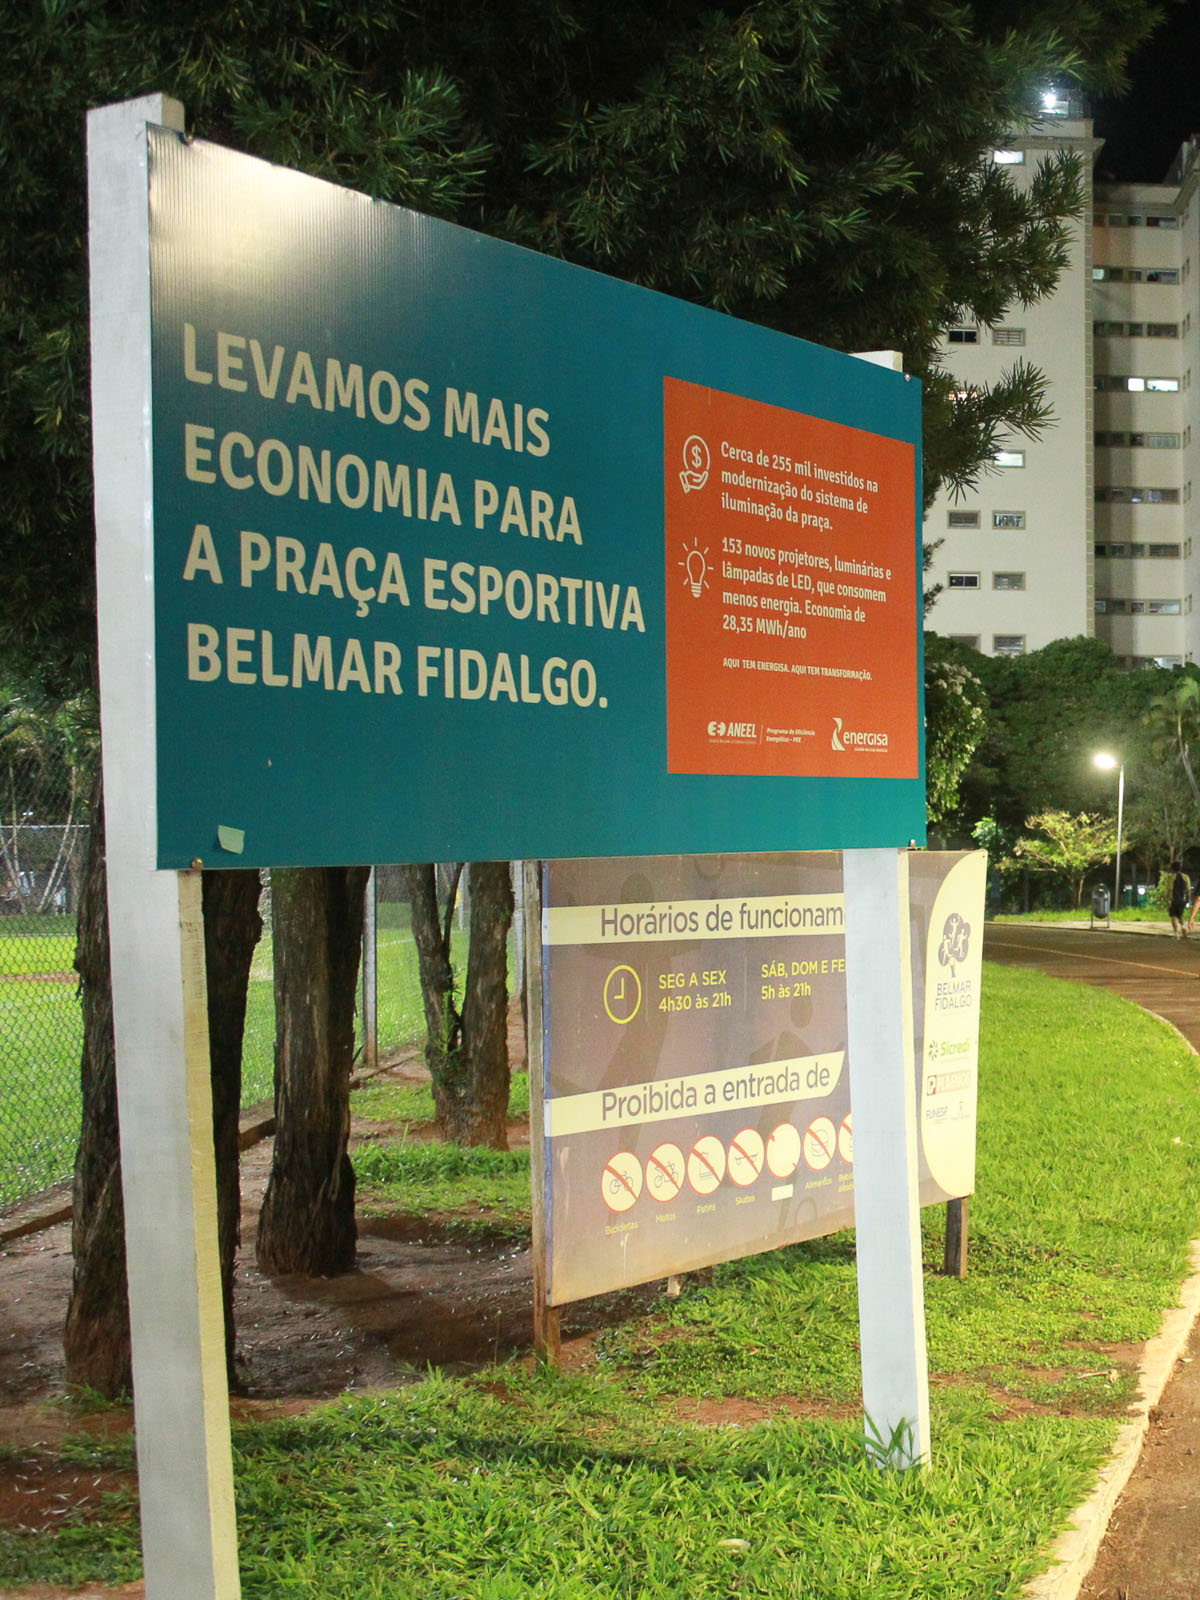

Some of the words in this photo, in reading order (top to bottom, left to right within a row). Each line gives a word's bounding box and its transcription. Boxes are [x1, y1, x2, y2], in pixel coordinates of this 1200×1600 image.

[184, 322, 431, 431] LEVAMOS
[444, 387, 551, 457] MAIS
[721, 441, 753, 463] Cerca
[756, 449, 770, 467] de
[772, 454, 792, 472] 255
[794, 460, 812, 477] mil
[813, 463, 865, 490] investidos
[866, 479, 879, 493] na
[184, 423, 462, 526] ECONOMIA
[474, 479, 583, 545] PARA
[721, 470, 798, 500] modernização
[800, 484, 814, 501] do
[815, 489, 855, 511] sistema
[856, 497, 868, 514] de
[721, 492, 783, 522] iluminação
[785, 505, 799, 523] da
[801, 513, 833, 532] praça.
[722, 536, 743, 555] 153
[745, 543, 776, 561] novos
[778, 548, 833, 573] projetores,
[834, 555, 885, 580] luminárias
[885, 568, 892, 581] e
[182, 524, 223, 584] A
[239, 530, 411, 617] PRAÇA
[423, 557, 646, 632] ESPORTIVA
[722, 560, 775, 585] lâmpadas
[776, 570, 789, 587] de
[791, 572, 815, 594] LED,
[816, 580, 835, 597] que
[836, 583, 887, 602] consomem
[722, 591, 759, 608] menos
[760, 597, 802, 617] energia.
[804, 599, 852, 621] Economia
[854, 606, 866, 623] de
[722, 614, 753, 634] 28,35
[756, 617, 807, 639] MWh/ano
[187, 622, 403, 695] BELMAR
[416, 645, 608, 708] FIDALGO.
[723, 657, 740, 669] AQUI
[742, 659, 756, 669] TEM
[757, 661, 790, 673] ENERGISA.
[791, 664, 807, 676] AQUI
[807, 665, 820, 676] TEM
[821, 667, 873, 682] TRANSFORMAÇÃO.
[727, 722, 757, 738] ANEEL
[843, 731, 889, 747] energisa
[601, 905, 699, 937] Horários
[705, 903, 733, 932] de
[658, 973, 686, 990] SEG
[689, 972, 699, 987] A
[702, 970, 727, 986] SEX
[761, 959, 788, 978] SÁB,
[791, 960, 818, 975] DOM
[821, 959, 829, 974] E
[658, 994, 692, 1012] 4h30
[695, 995, 709, 1009] às
[712, 991, 732, 1008] 21h
[761, 985, 776, 1000] 5h
[778, 983, 791, 998] às
[793, 982, 812, 997] 21h
[934, 994, 973, 1010] FIDALGO
[936, 980, 972, 997] BELMAR
[602, 1080, 698, 1121] Proibida
[704, 1083, 716, 1105] a
[722, 1066, 800, 1101] entrada
[805, 1062, 831, 1089] de
[656, 1213, 677, 1224] Motos
